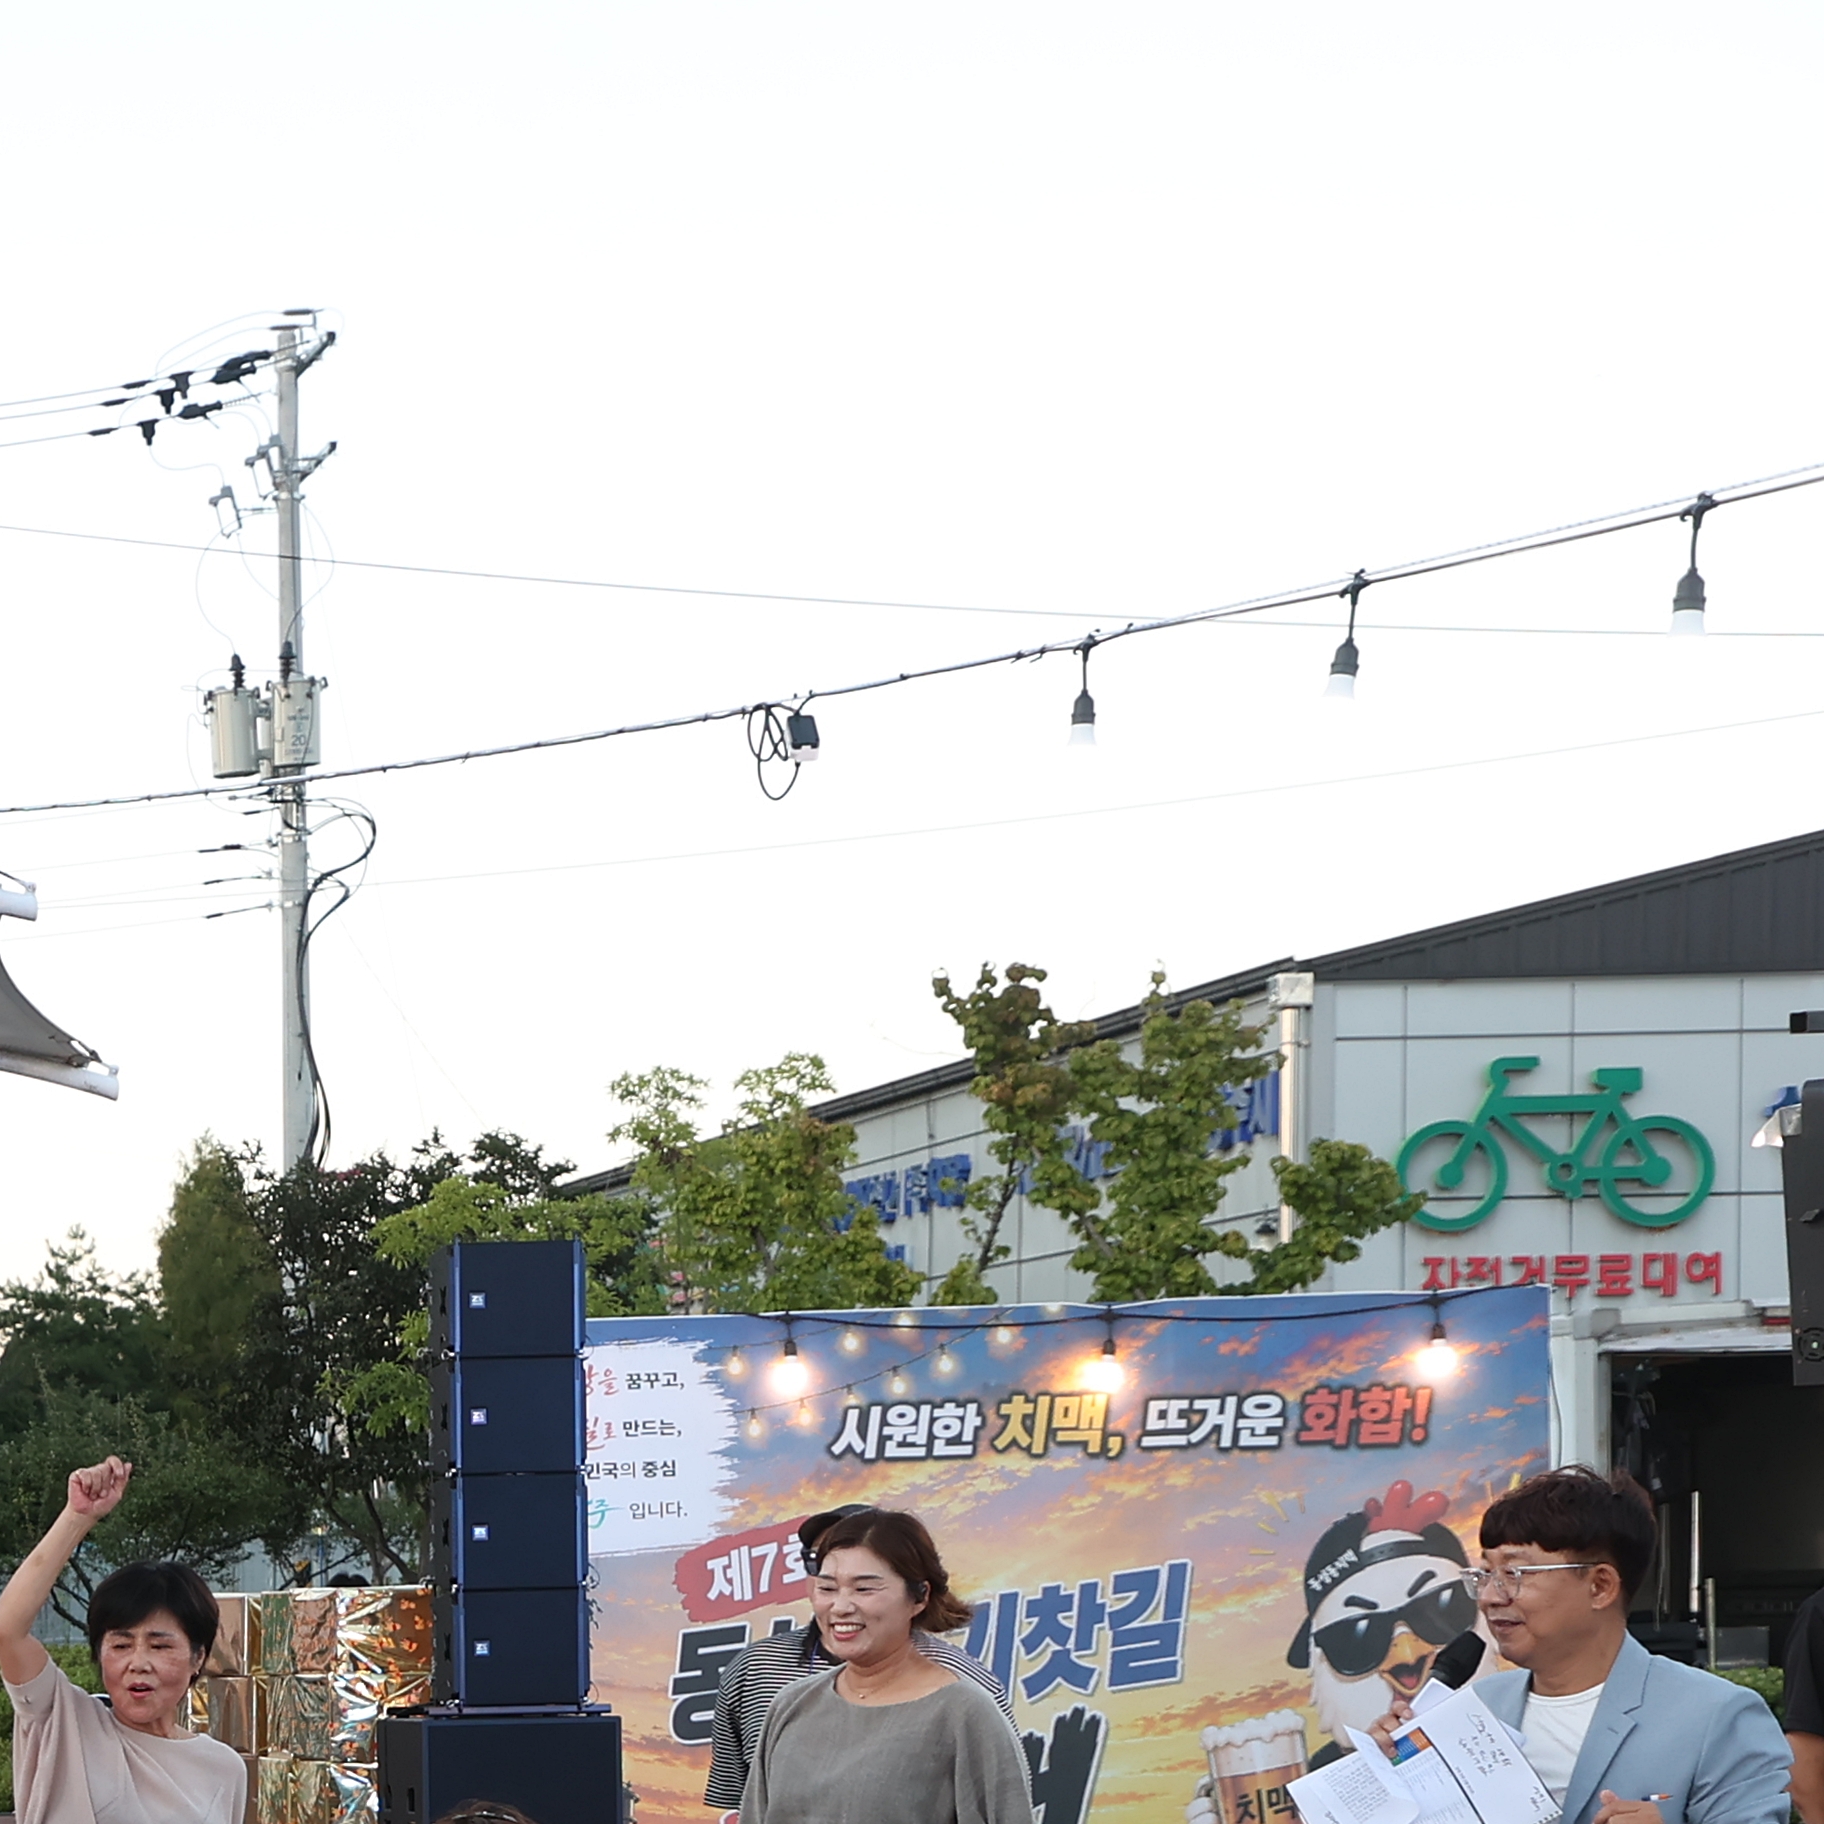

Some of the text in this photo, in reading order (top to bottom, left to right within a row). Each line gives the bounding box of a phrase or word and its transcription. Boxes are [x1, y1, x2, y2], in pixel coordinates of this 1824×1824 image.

[625, 1372, 685, 1390] 꿈꾸고,
[623, 1420, 682, 1438] 만드는,
[830, 1384, 1432, 1463] 시원한 치맥, 뜨거운 화합!
[641, 1460, 677, 1478] 중심
[629, 1501, 688, 1520] 입니다.
